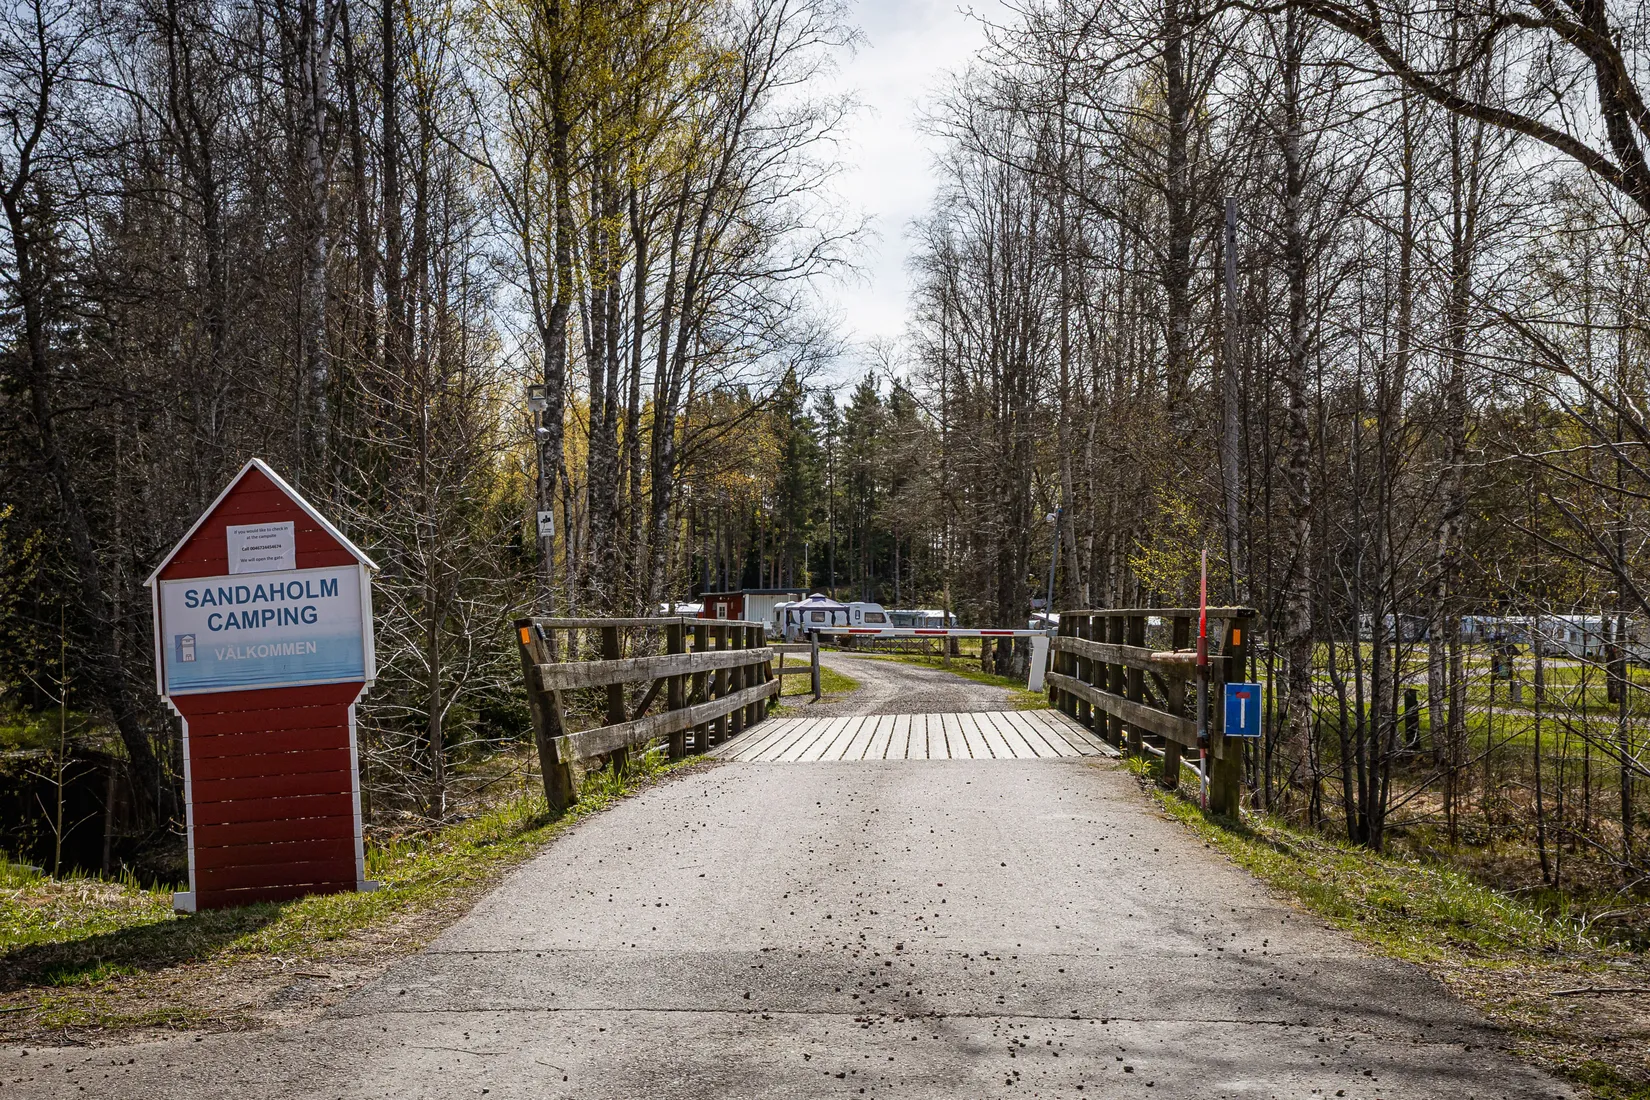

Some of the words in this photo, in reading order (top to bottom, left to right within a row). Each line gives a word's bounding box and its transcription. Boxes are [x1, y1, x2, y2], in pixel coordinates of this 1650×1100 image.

[185, 578, 338, 608] SANDAHOLM
[207, 605, 318, 632] CAMPING
[215, 641, 316, 661] VÄLKOMMEN
